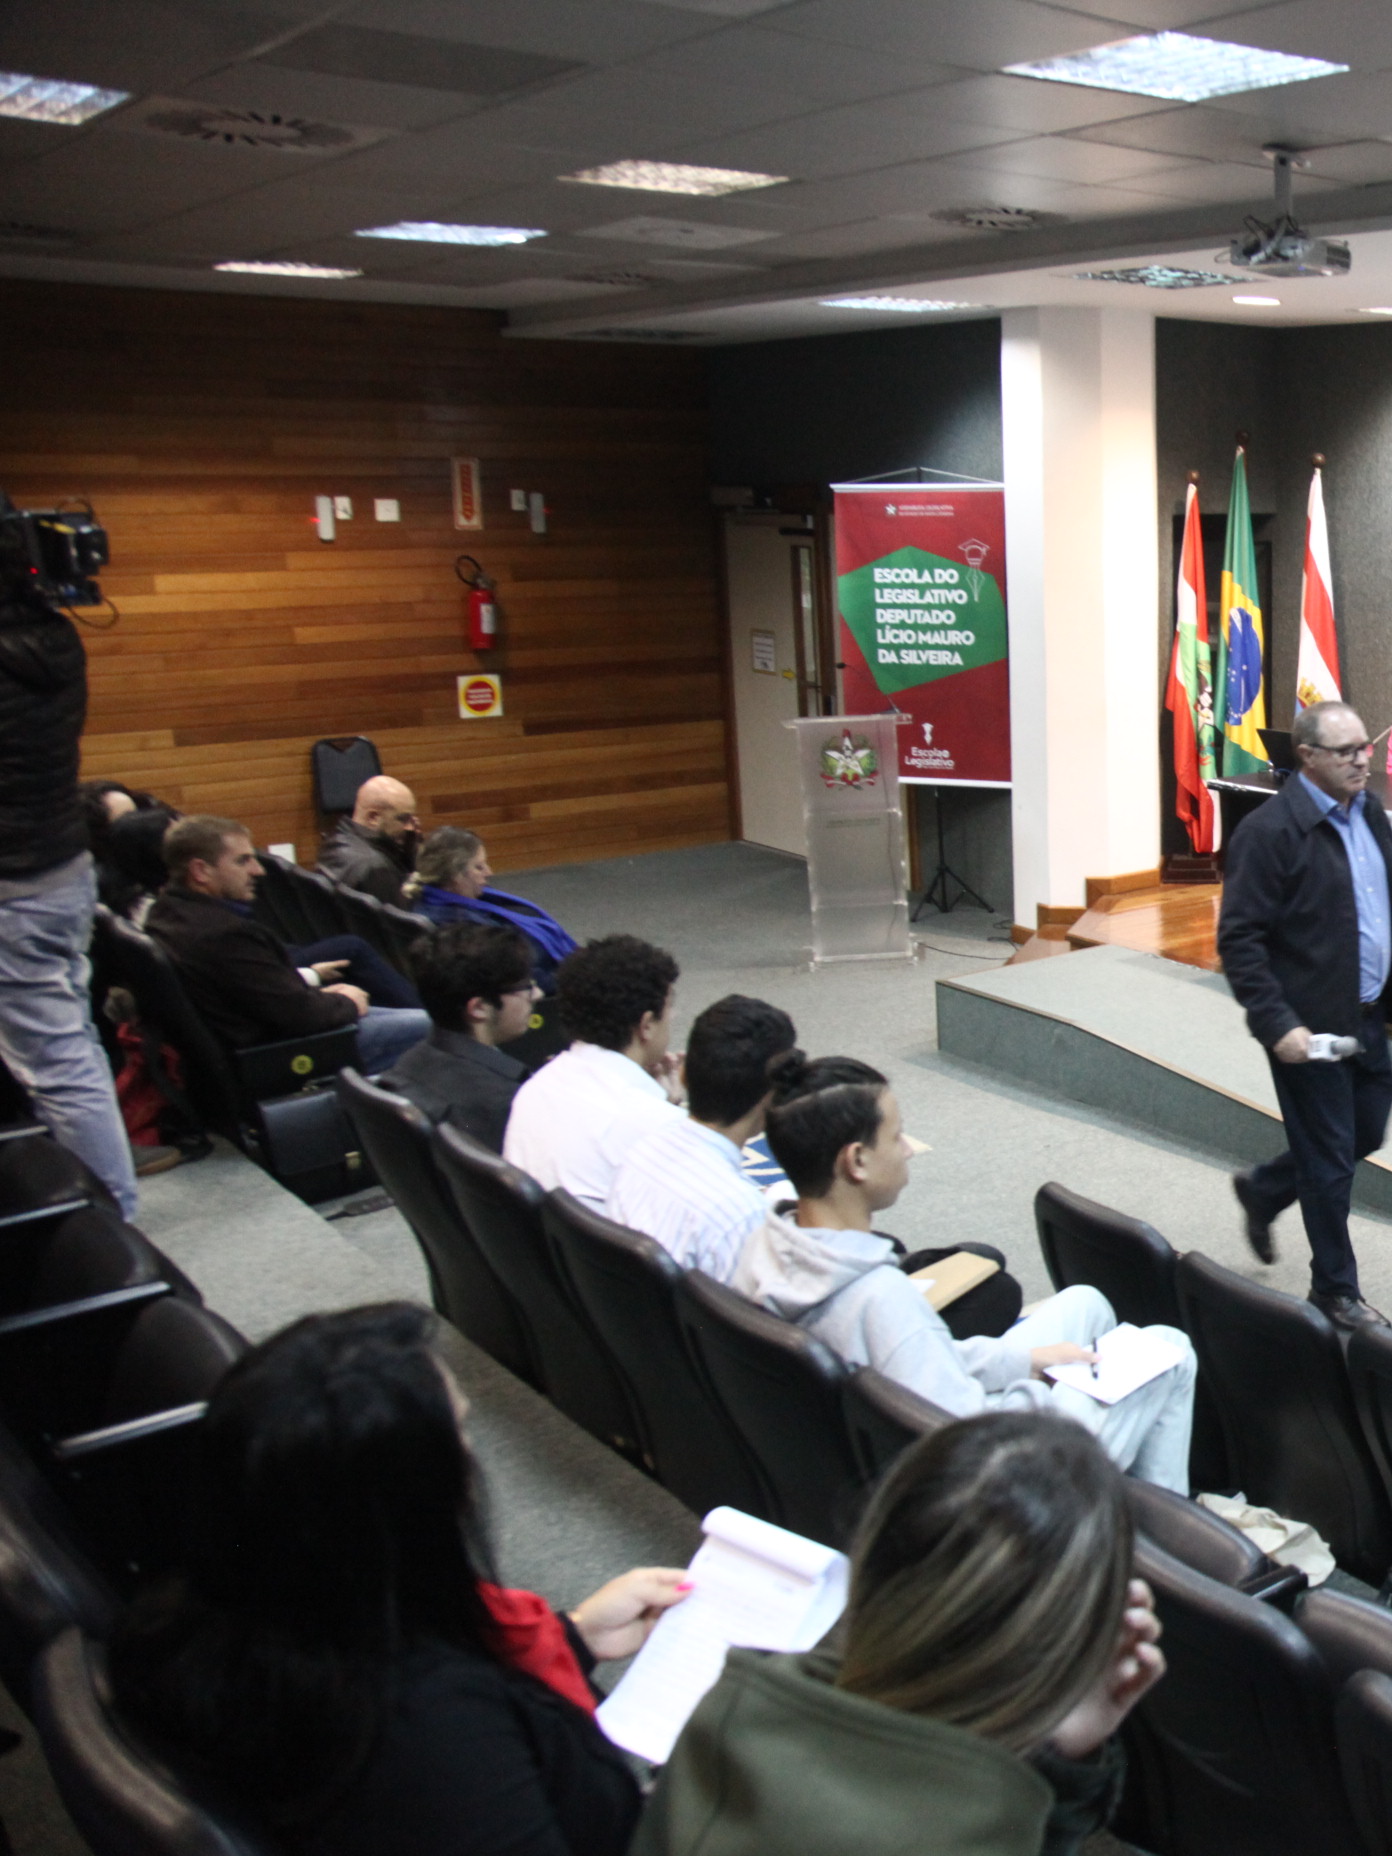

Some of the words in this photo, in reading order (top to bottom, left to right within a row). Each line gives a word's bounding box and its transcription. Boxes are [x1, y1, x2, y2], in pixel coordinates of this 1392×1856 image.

[873, 567, 931, 584] ESCOLA
[934, 568, 959, 584] DO
[874, 588, 968, 605] LEGISLATIVO
[875, 608, 956, 625] DEPUTADO
[876, 624, 917, 645] LÍCIO
[918, 630, 975, 646] MAURO
[878, 649, 899, 664] DA
[901, 650, 963, 666] SILVEIRA
[911, 746, 943, 757] Escola
[904, 755, 955, 768] Legislativo
